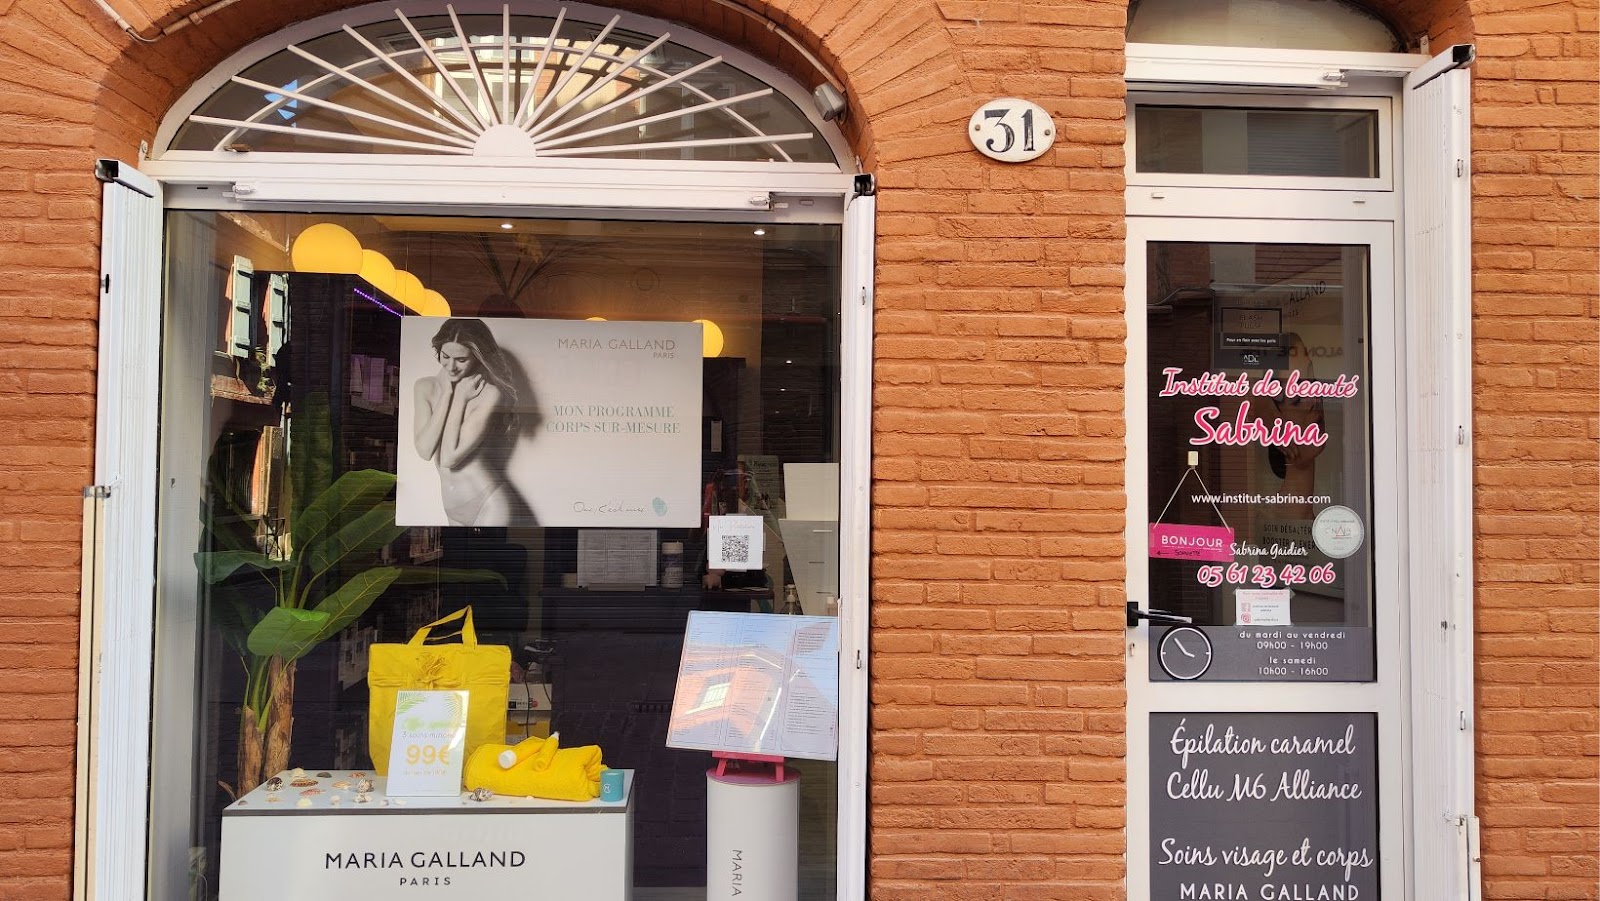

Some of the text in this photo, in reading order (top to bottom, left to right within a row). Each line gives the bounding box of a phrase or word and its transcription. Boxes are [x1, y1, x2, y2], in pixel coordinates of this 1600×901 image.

[984, 109, 1036, 153] 31
[558, 338, 676, 351] MARIA GALLAND
[1159, 367, 1360, 398] Institut de beauté
[553, 405, 675, 418] MON PROGRAMME
[546, 420, 681, 434] CORPS SUR-MESURE
[1189, 400, 1328, 447] Sabrina
[1191, 492, 1331, 504] www.institut-sabrina.com
[1280, 522, 1313, 535] DÉSALTÉR
[1161, 534, 1223, 548] BONJOUR
[1229, 541, 1309, 559] Sabrina Gaidier
[1197, 562, 1336, 588] 05 61 23 42 06
[1239, 631, 1251, 639] du
[1255, 631, 1282, 639] mardi
[1302, 631, 1346, 639] vendredi
[1256, 641, 1287, 650] 09h00
[1299, 641, 1328, 650] 19h00
[1269, 656, 1316, 665] le samedi
[1258, 667, 1287, 676] 10h00
[1299, 667, 1329, 676] 16h00
[1170, 718, 1356, 769] Épilation caramel
[405, 743, 450, 766] 99€
[1167, 769, 1362, 801] Cellu M6 Alliance
[325, 850, 526, 869] MARIA GALLAND
[1158, 837, 1374, 882] Soins visage et corps
[399, 876, 451, 886] PARIS
[731, 849, 743, 897] MARIA
[1180, 883, 1359, 901] MARIA GALLAND
